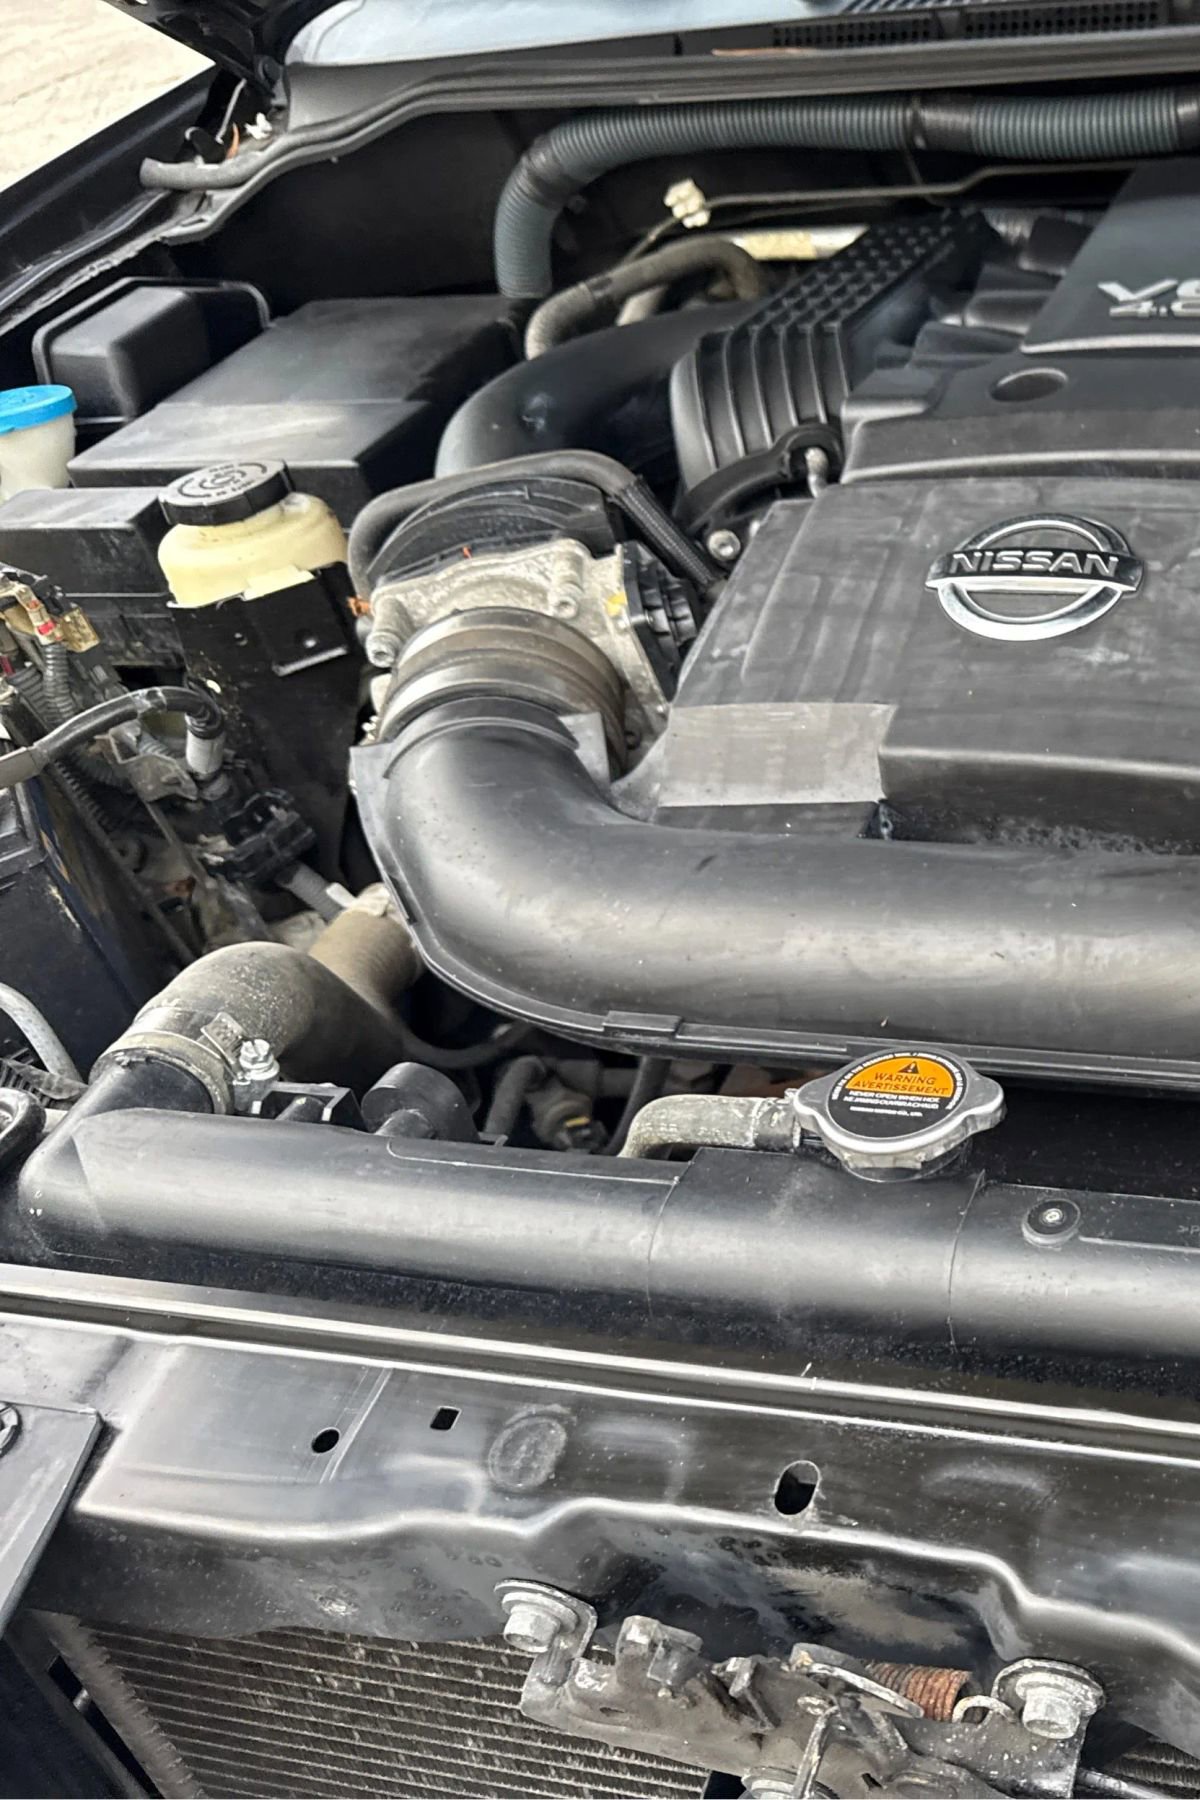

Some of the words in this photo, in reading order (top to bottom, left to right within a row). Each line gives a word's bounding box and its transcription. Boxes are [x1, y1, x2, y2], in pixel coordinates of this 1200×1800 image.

[952, 551, 1118, 577] NISSAN
[874, 1072, 936, 1085] WARNING
[854, 1081, 948, 1094] AVERTISSEMENT
